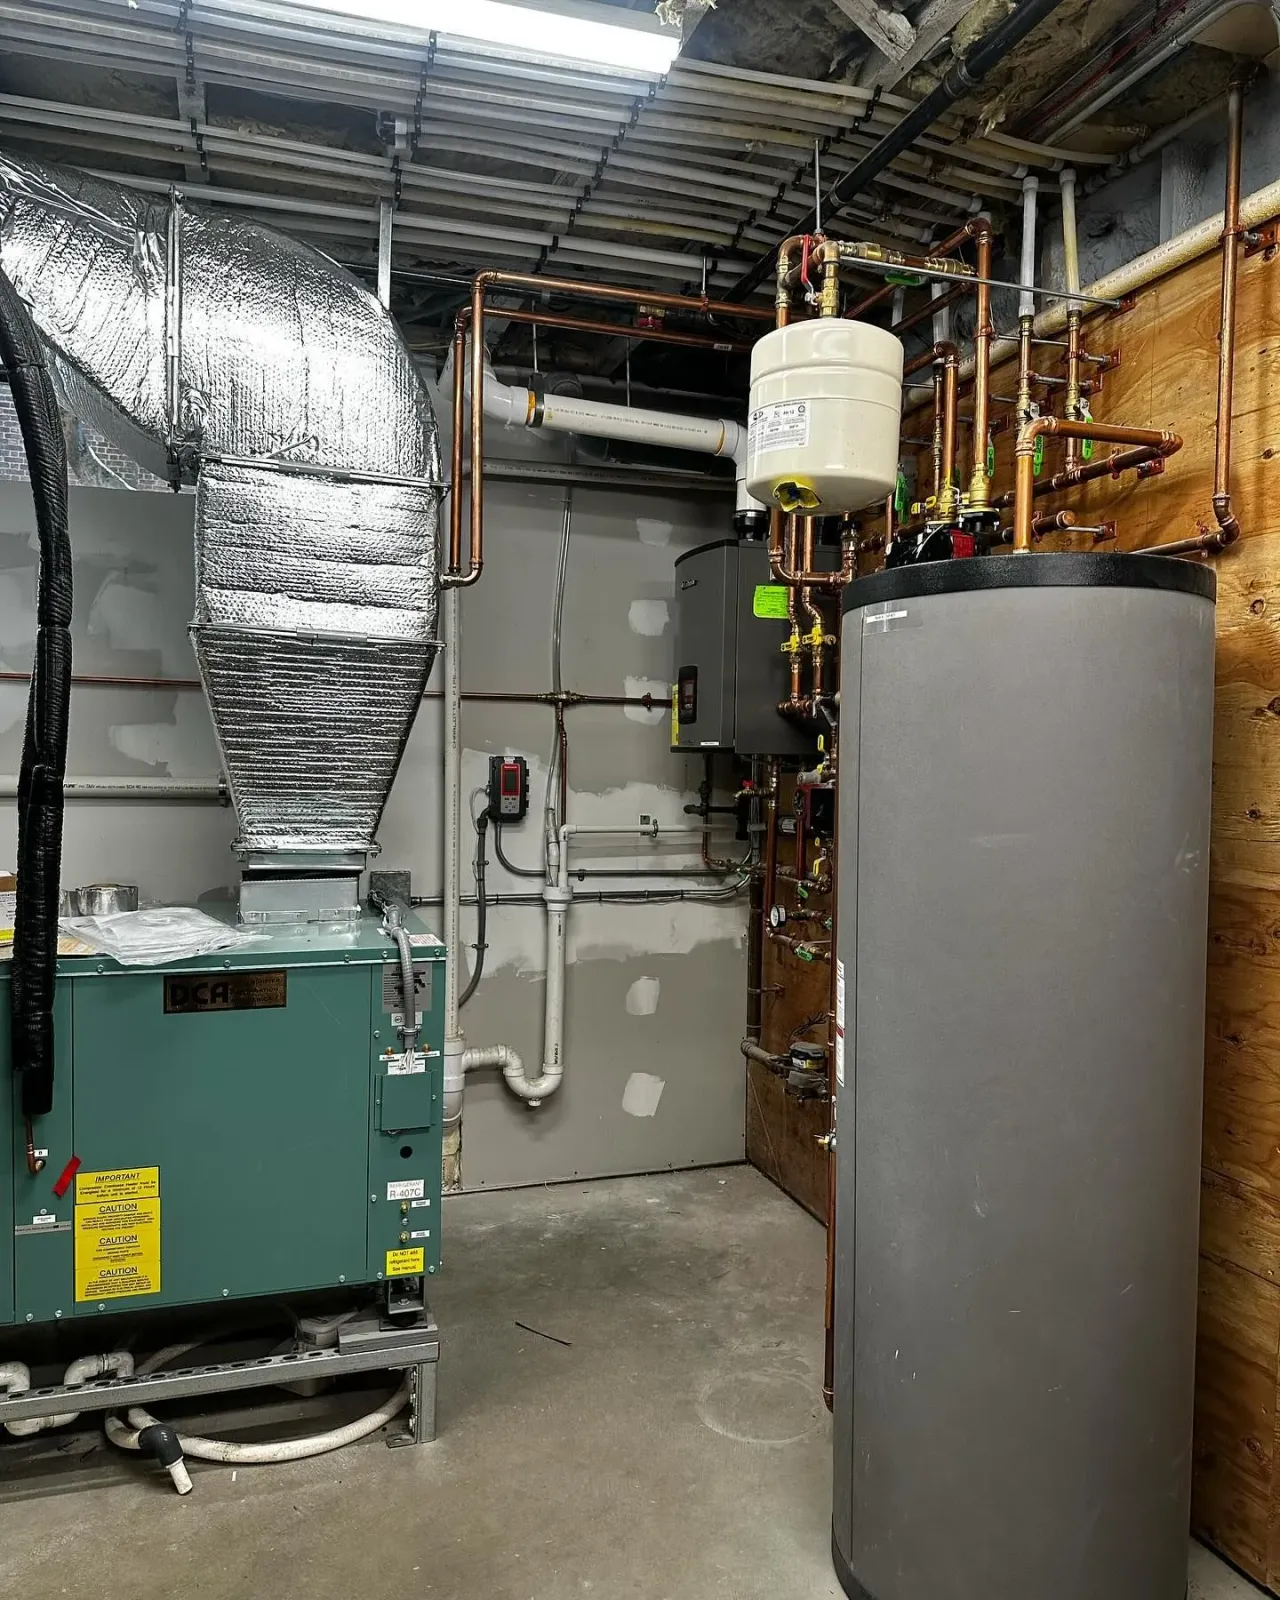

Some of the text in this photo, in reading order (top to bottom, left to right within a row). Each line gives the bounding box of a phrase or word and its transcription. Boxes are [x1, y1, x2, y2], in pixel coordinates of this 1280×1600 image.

[170, 981, 229, 1006] DCA
[95, 1172, 141, 1183] IMPORTANT
[389, 1187, 421, 1198] R-407C
[99, 1203, 138, 1213] CAUTION
[99, 1234, 138, 1245] CAUTION
[99, 1266, 138, 1277] CAUTION
